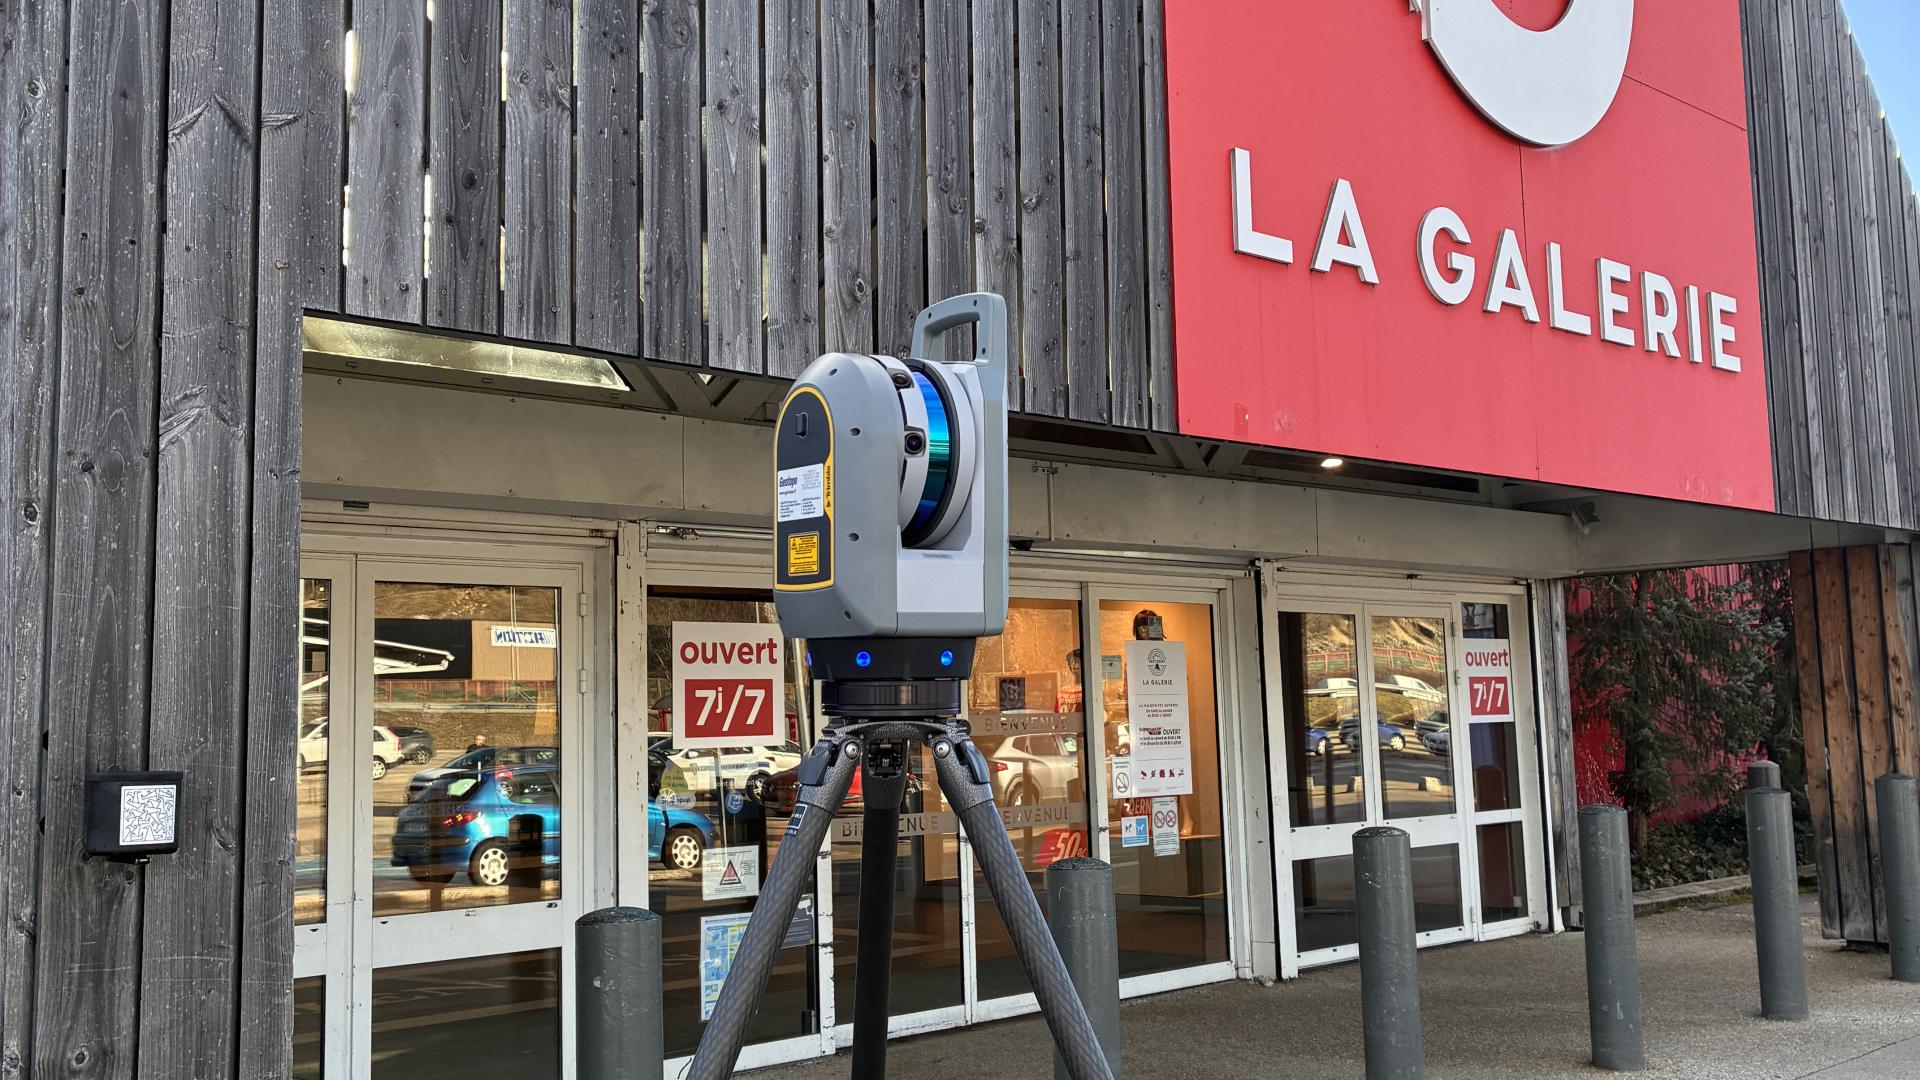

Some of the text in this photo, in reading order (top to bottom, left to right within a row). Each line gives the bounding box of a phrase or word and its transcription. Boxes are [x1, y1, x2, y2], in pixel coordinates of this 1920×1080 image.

[1230, 146, 1741, 373] LA GALERIE
[680, 638, 778, 664] ouvert
[1465, 648, 1509, 667] ouvert
[694, 684, 766, 732] 7j/7
[1473, 680, 1505, 712] 7j/7
